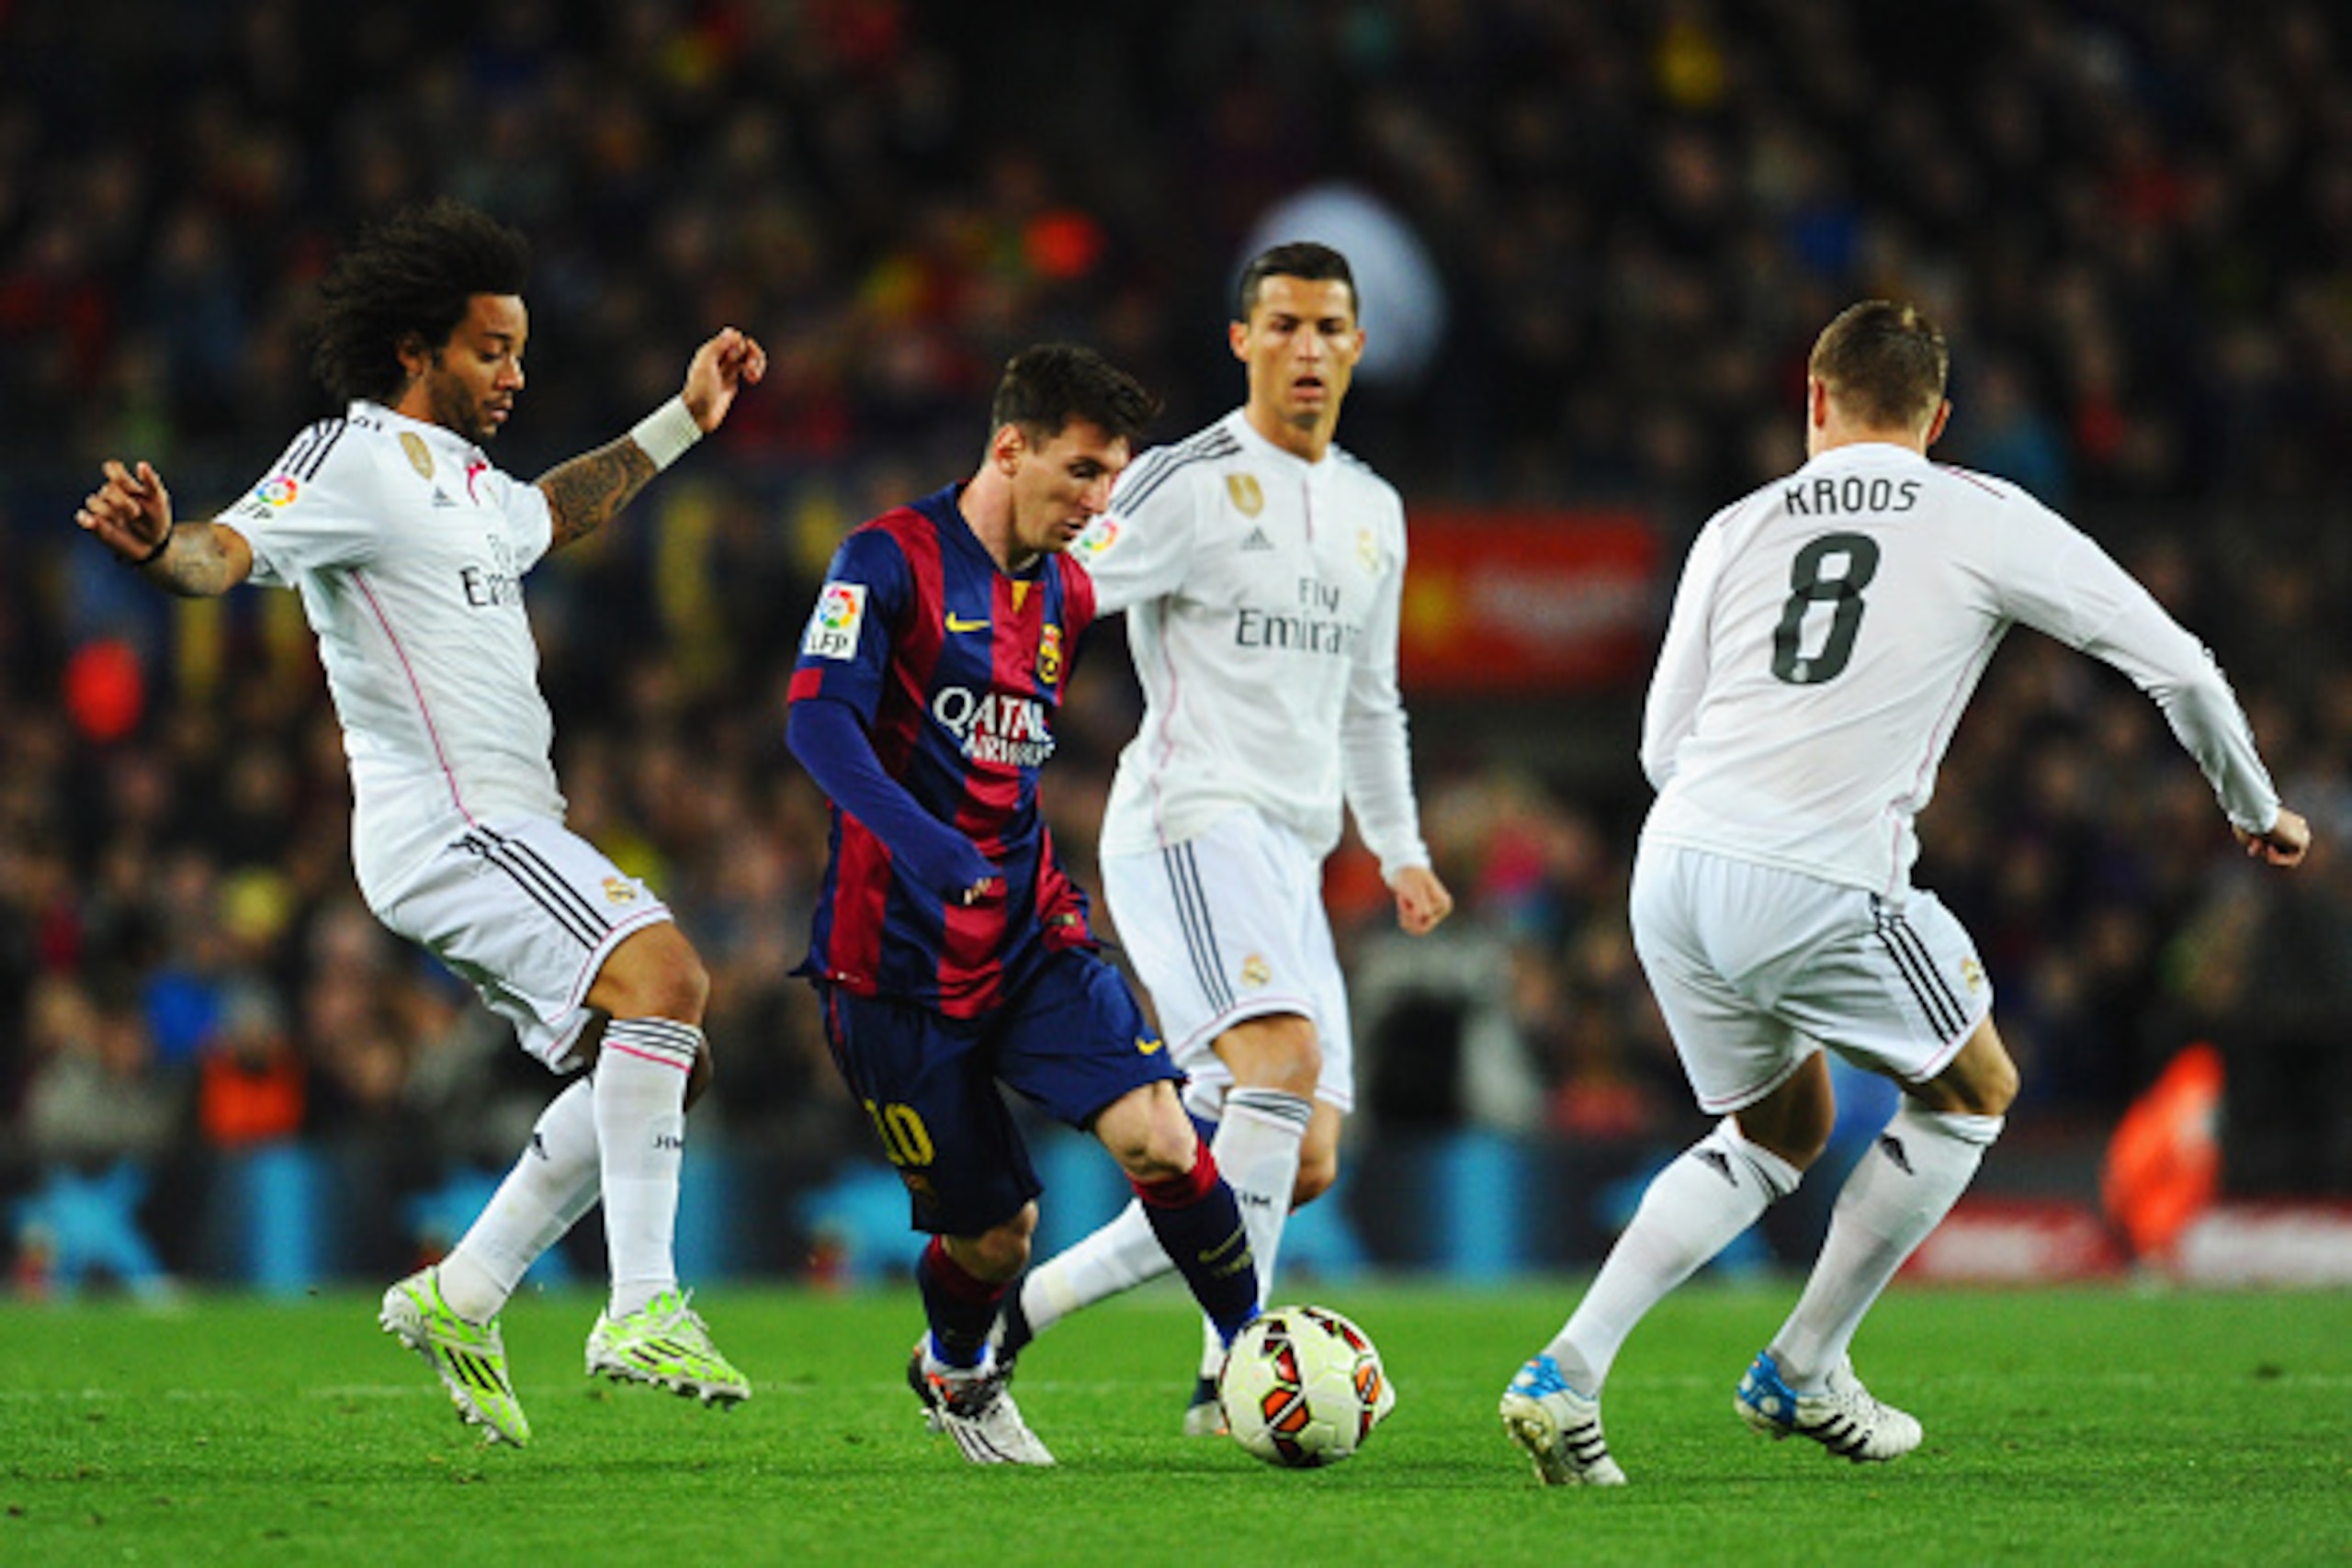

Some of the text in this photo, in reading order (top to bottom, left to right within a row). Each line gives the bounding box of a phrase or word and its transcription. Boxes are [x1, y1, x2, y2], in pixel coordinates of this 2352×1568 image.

[1786, 477, 1922, 516] KROOS
[1298, 578, 1340, 615] Fly
[1770, 530, 1881, 685] 8
[865, 1099, 934, 1166] 10
